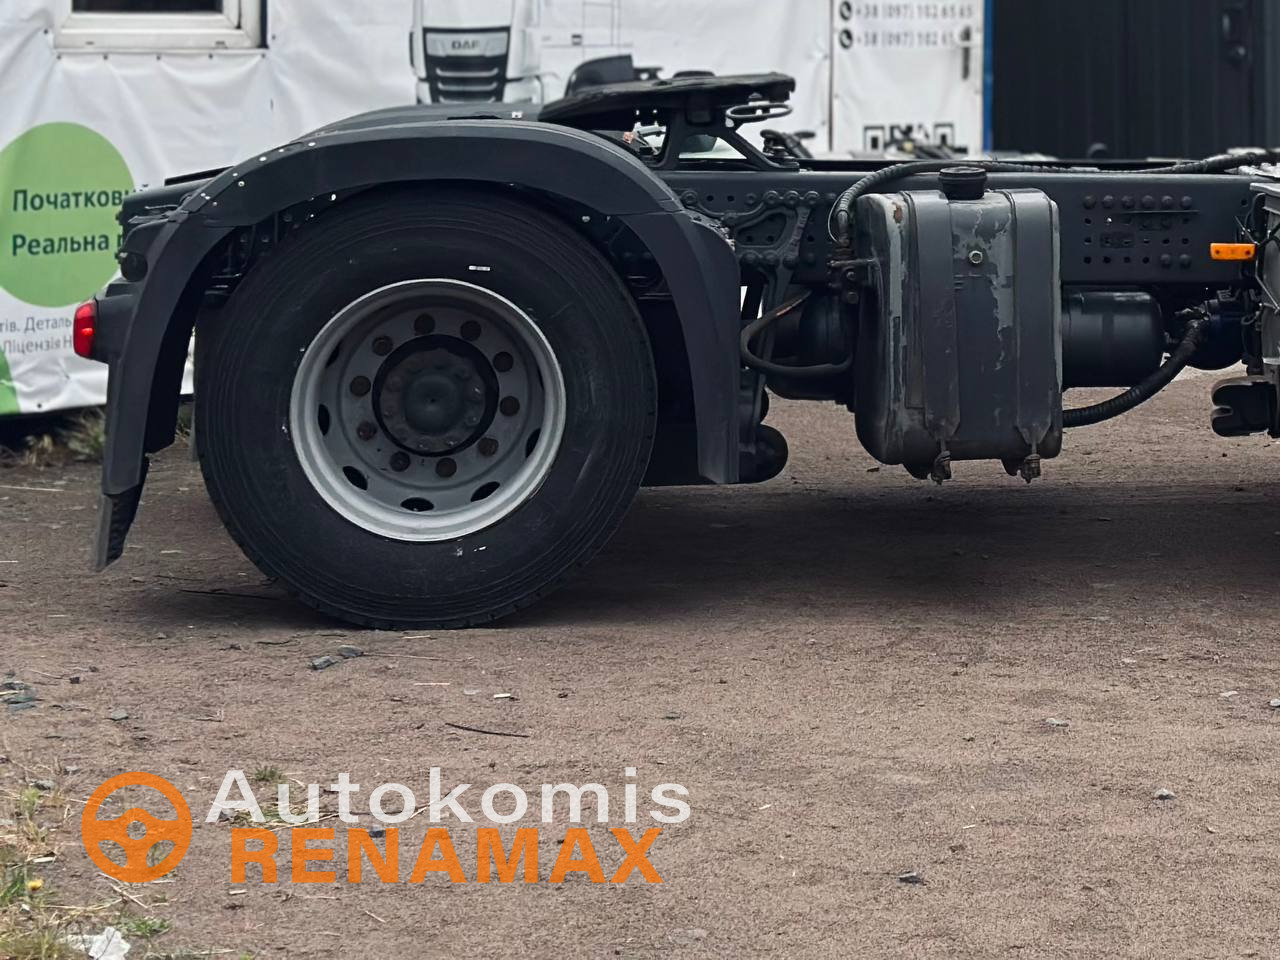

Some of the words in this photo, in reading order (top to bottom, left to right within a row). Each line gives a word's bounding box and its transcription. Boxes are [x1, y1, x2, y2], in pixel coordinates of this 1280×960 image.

[451, 40, 481, 50] DAF
[13, 184, 148, 212] Початков
[12, 234, 110, 257] Реальна
